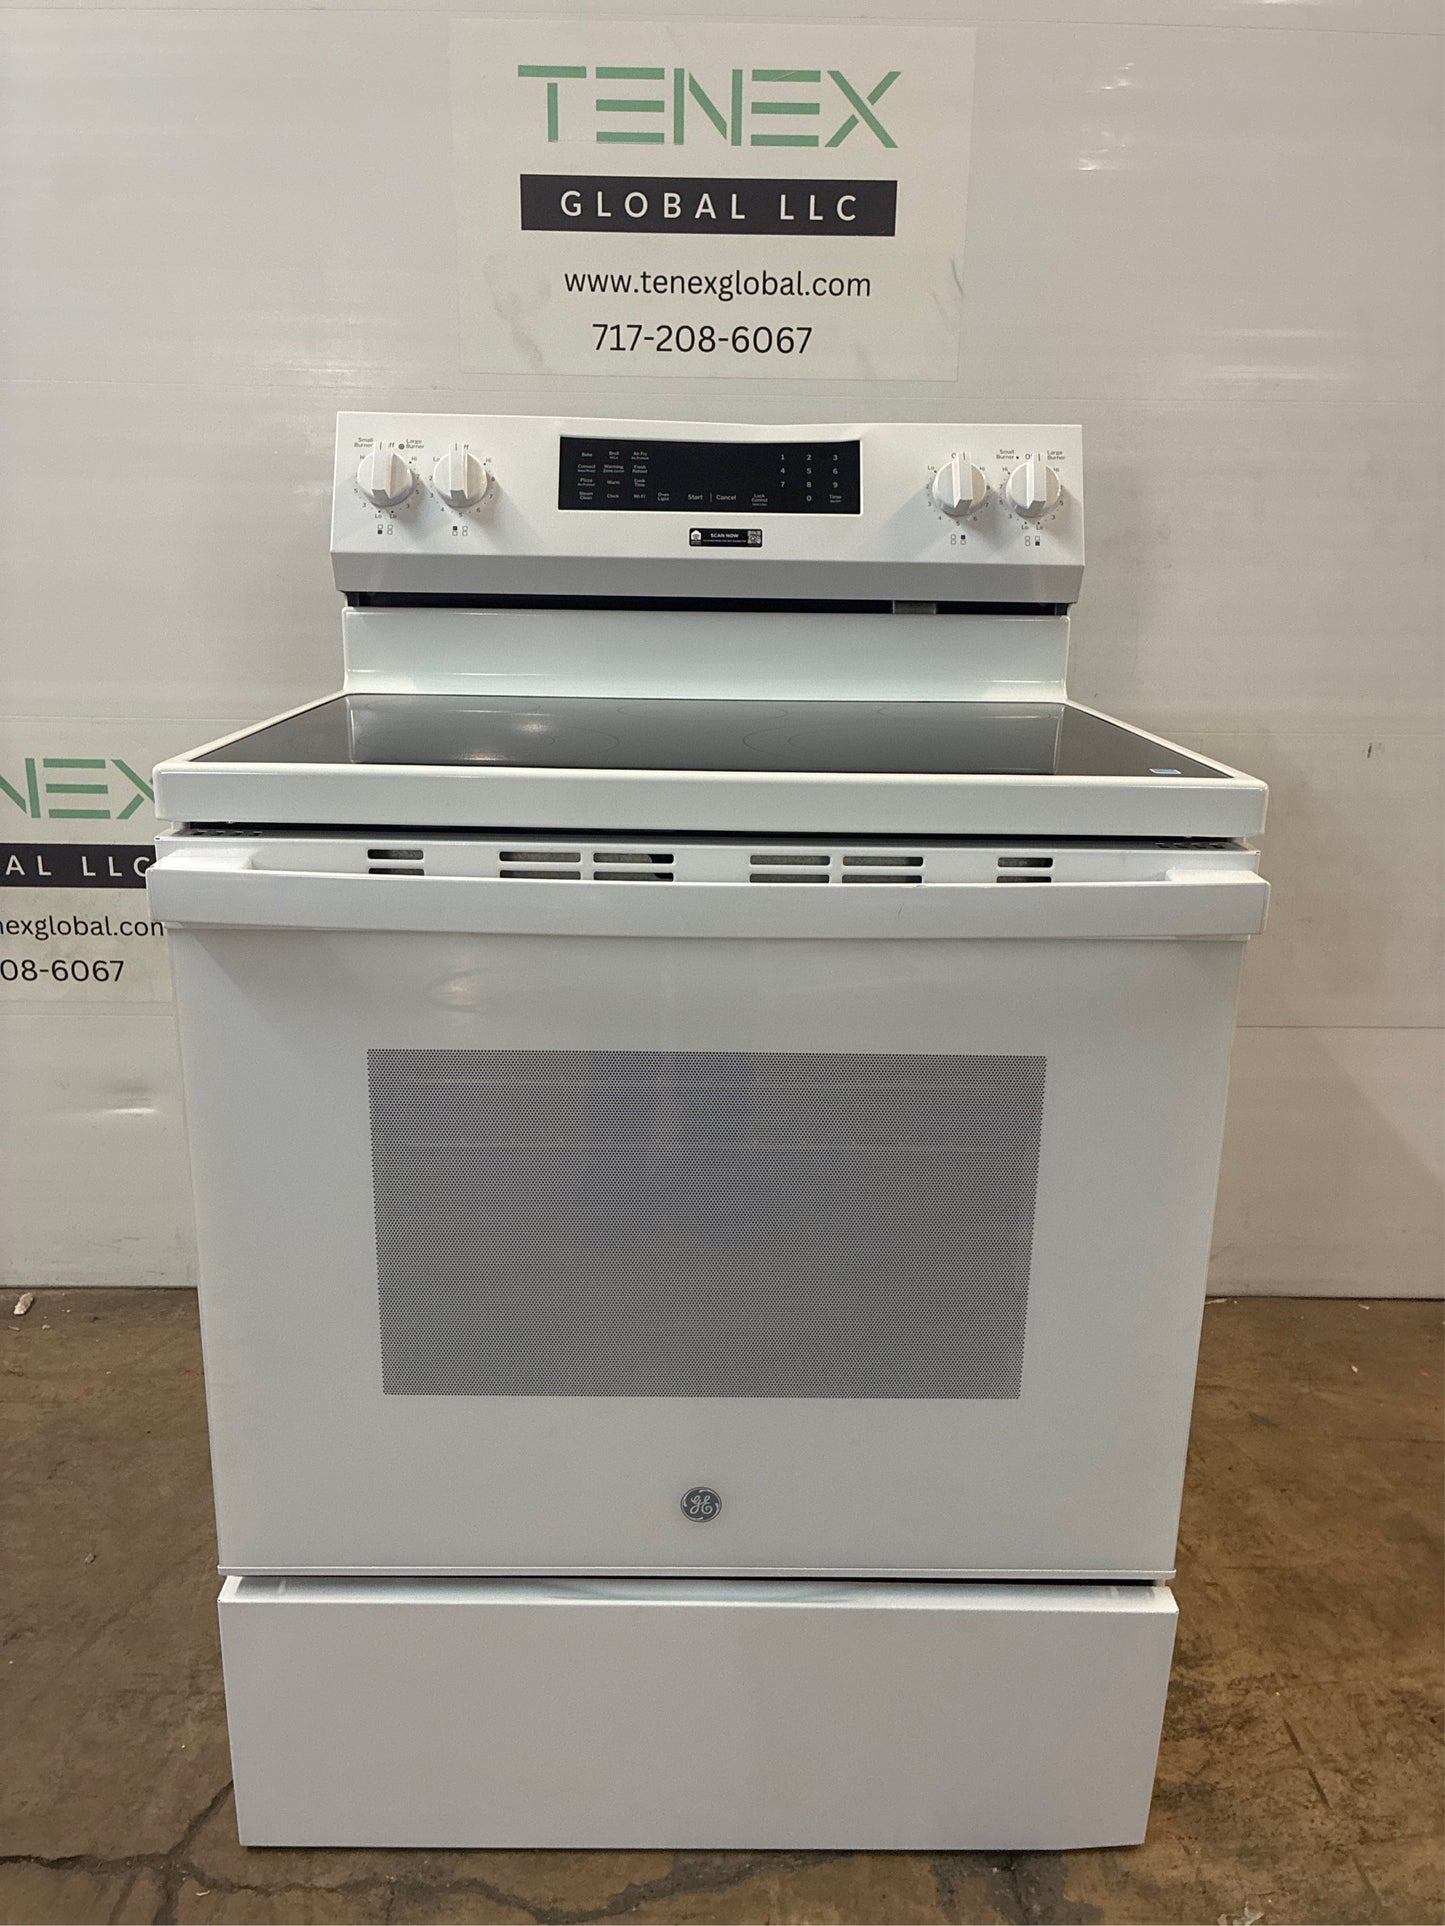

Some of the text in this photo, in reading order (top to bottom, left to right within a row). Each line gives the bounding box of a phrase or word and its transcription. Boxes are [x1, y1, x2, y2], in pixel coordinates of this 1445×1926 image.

[518, 64, 902, 148] TENEX
[560, 190, 857, 221] GLOBAL LLC
[564, 270, 871, 302] www.tenexglobal.com
[592, 323, 813, 354] 717-208-6067
[81, 856, 150, 877] LLC
